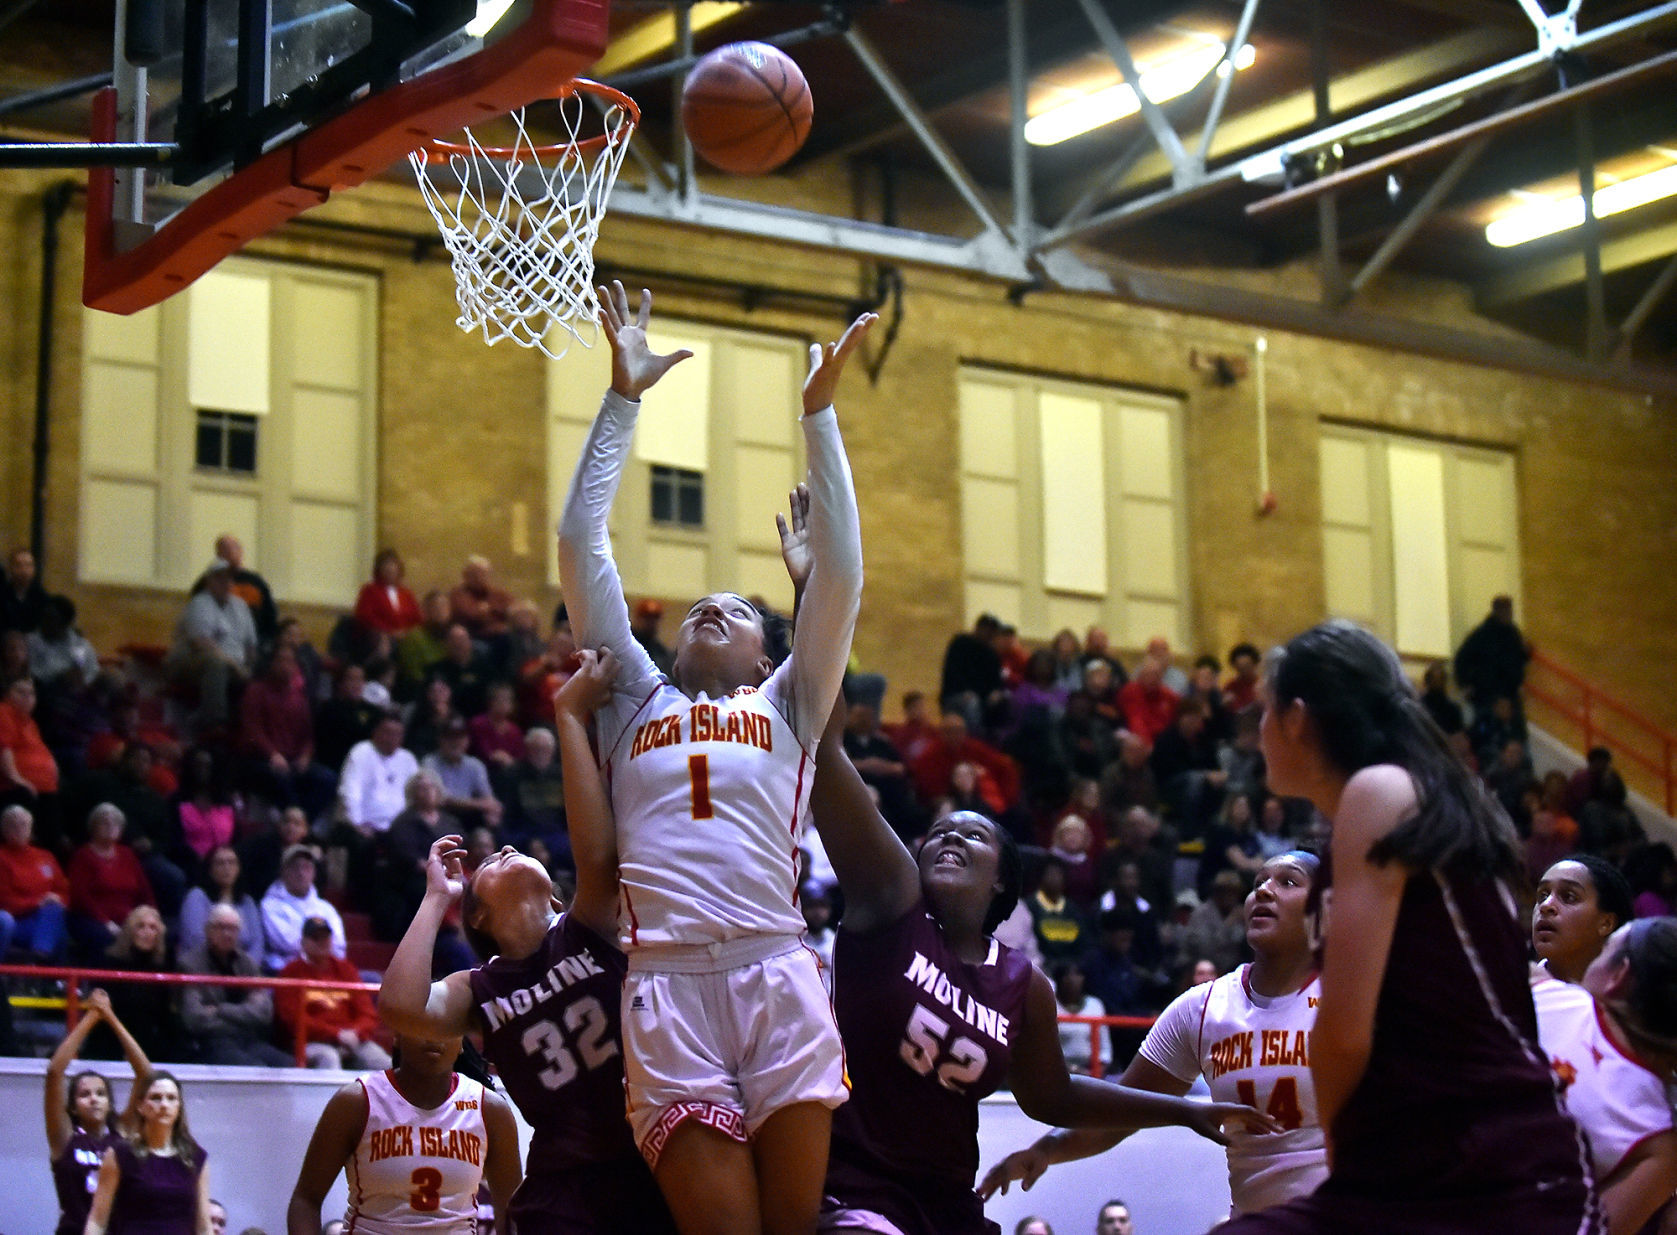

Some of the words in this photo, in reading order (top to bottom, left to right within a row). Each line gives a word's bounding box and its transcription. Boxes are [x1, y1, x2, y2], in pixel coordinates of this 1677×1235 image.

[630, 714, 682, 761] ROCK
[690, 703, 772, 752] ISLAND
[688, 754, 714, 820] 1
[480, 947, 605, 1032] MOLINE
[903, 950, 1010, 1047] MOLINE
[521, 995, 619, 1090] 32
[899, 1002, 989, 1096] 52
[1210, 1030, 1254, 1080] ROCK
[1259, 1030, 1312, 1067] ISLA
[1236, 1076, 1303, 1135] 14
[369, 1125, 414, 1163] ROCK
[418, 1126, 481, 1168] ISLAND
[409, 1166, 443, 1212] 3
